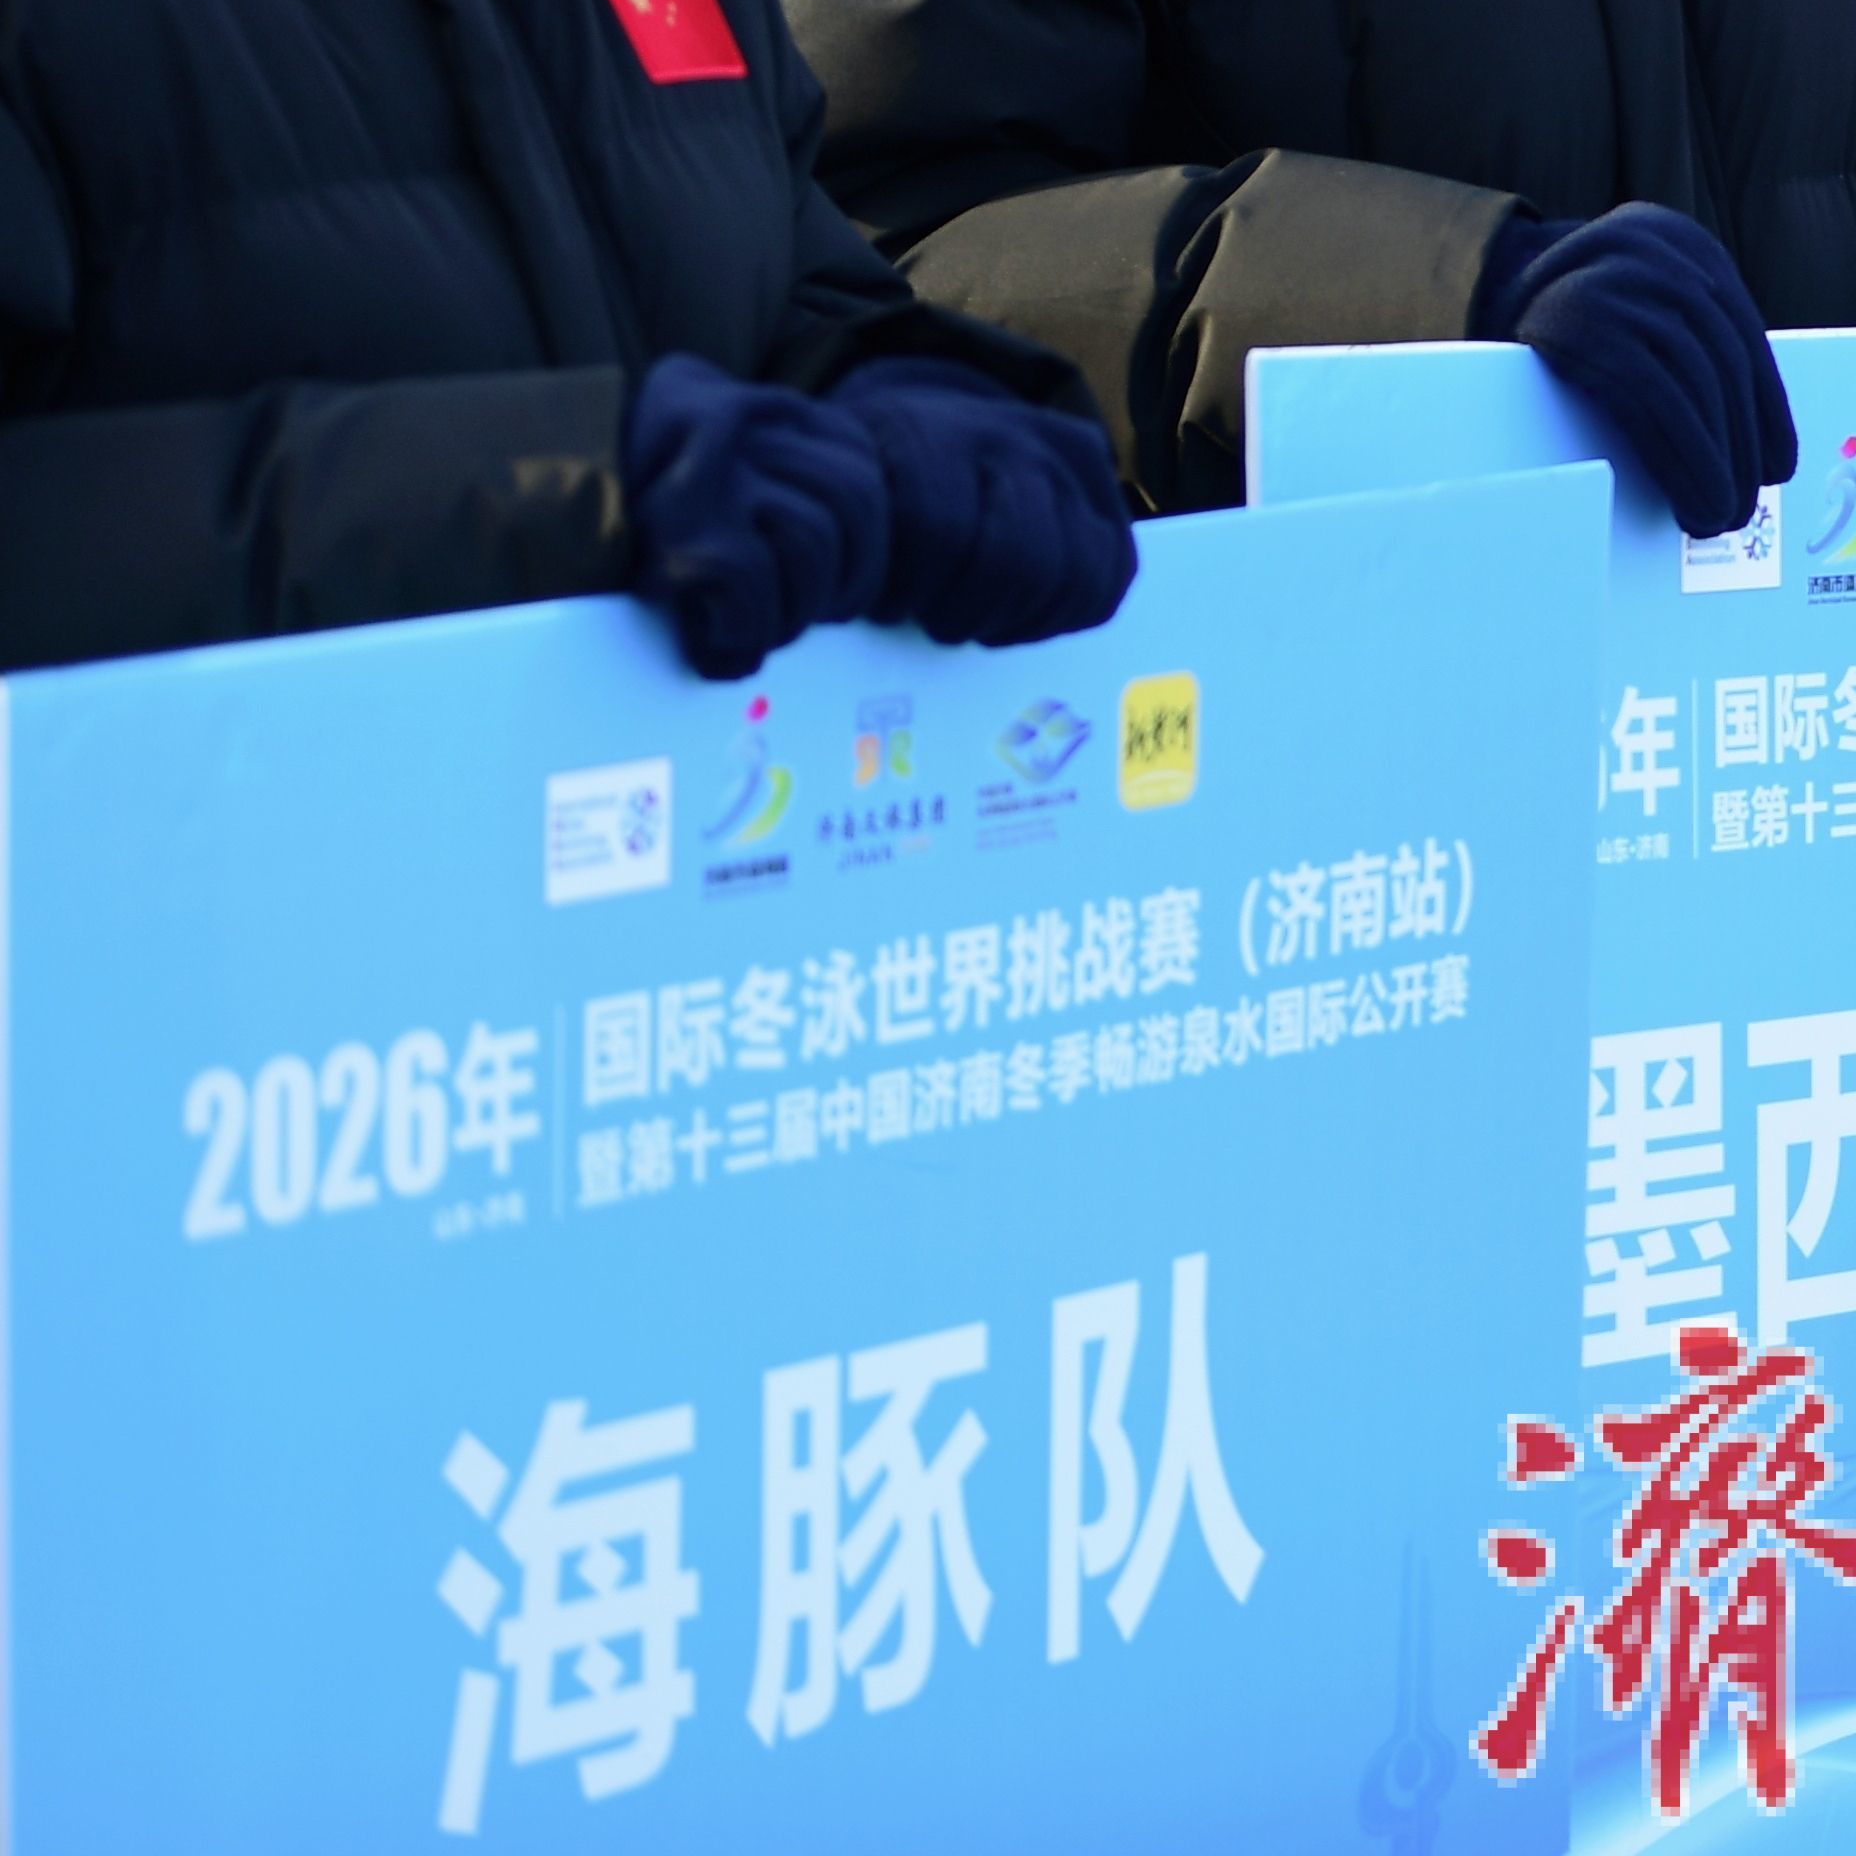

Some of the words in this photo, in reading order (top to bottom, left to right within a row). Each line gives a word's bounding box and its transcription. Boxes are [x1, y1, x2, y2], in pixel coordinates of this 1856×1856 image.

[1599, 685, 1680, 817] 年
[577, 954, 1469, 1209] 暨第十三届中国济南冬季畅游泉水国际公开赛
[582, 839, 1475, 1107] 国际冬泳世界挑战赛（济南站）
[184, 1019, 540, 1241] 2026年
[435, 1252, 1266, 1837] 海豚队
